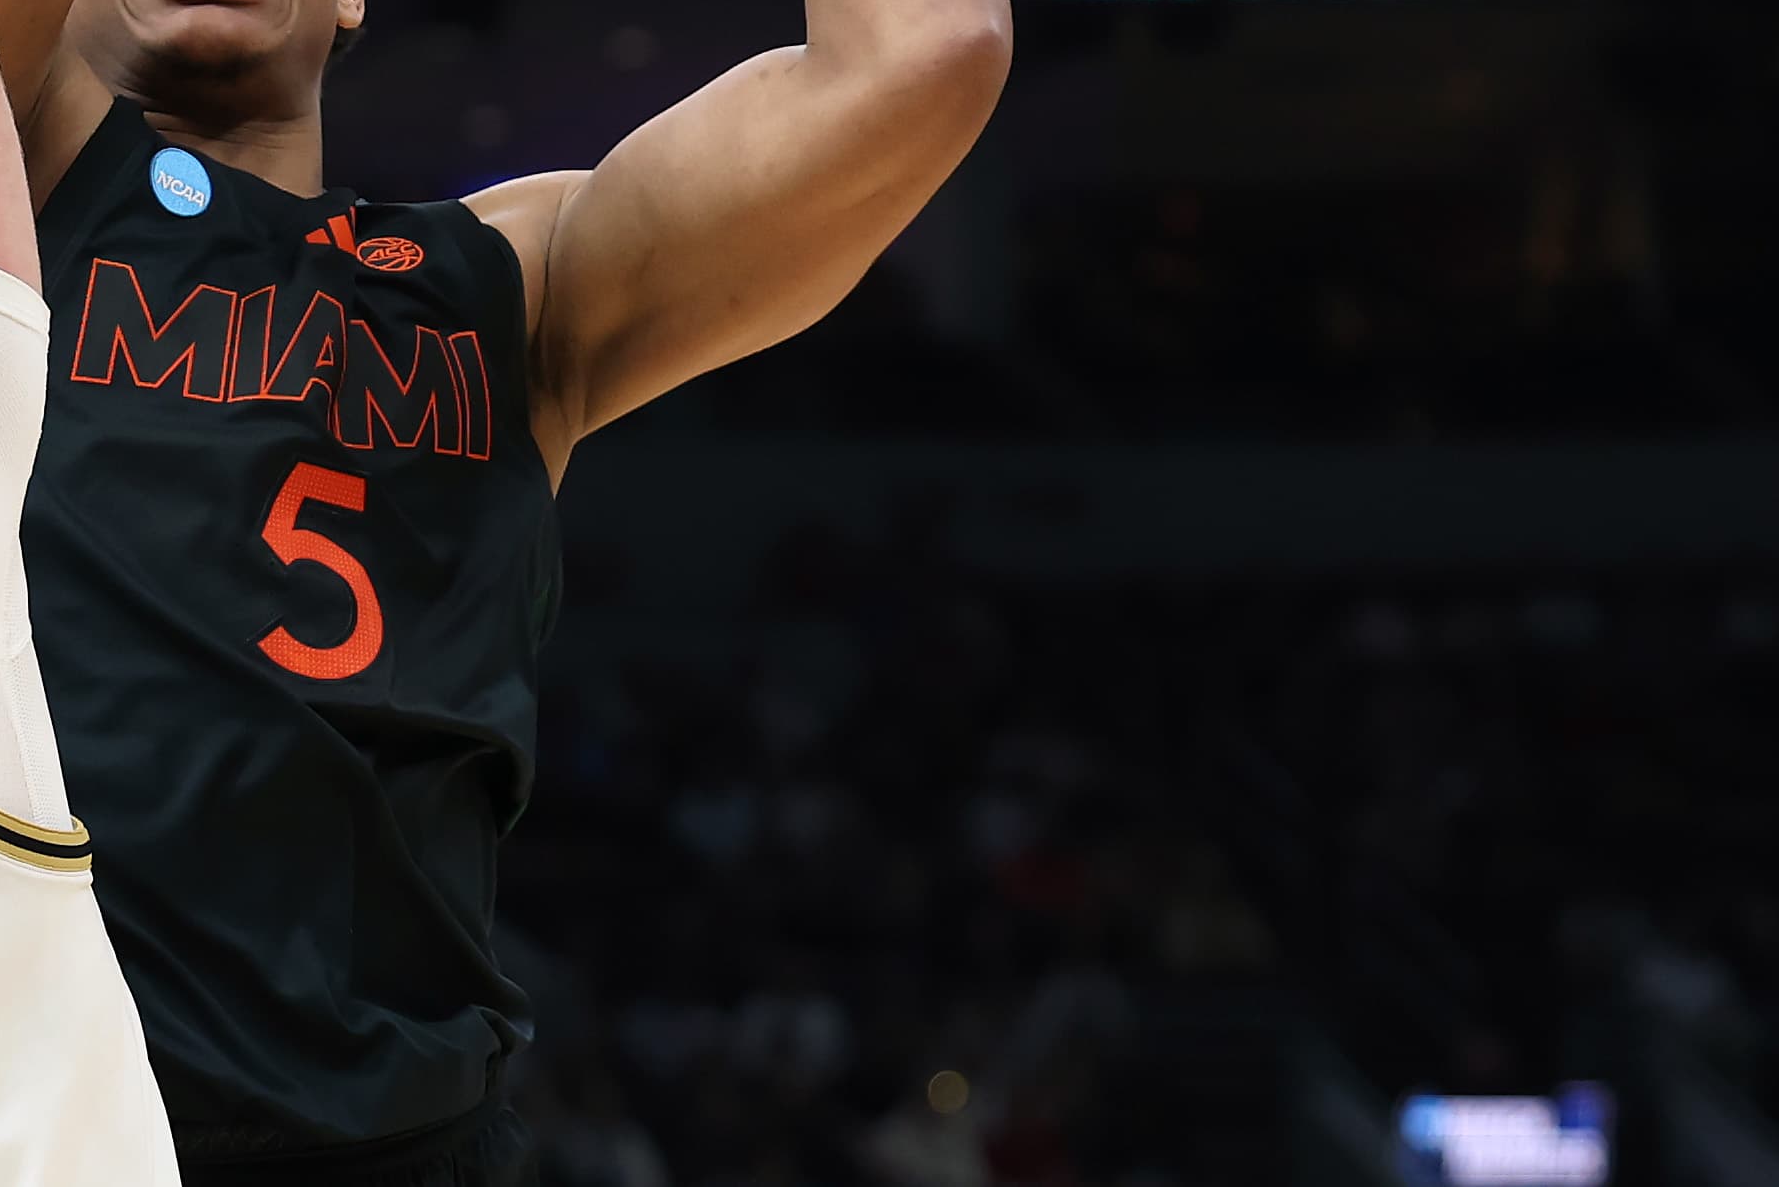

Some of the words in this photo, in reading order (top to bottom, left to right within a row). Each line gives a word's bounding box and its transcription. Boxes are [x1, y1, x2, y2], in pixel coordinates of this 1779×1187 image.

[156, 170, 206, 207] NCAA
[70, 257, 491, 462] MIAMI
[257, 461, 385, 680] 5
